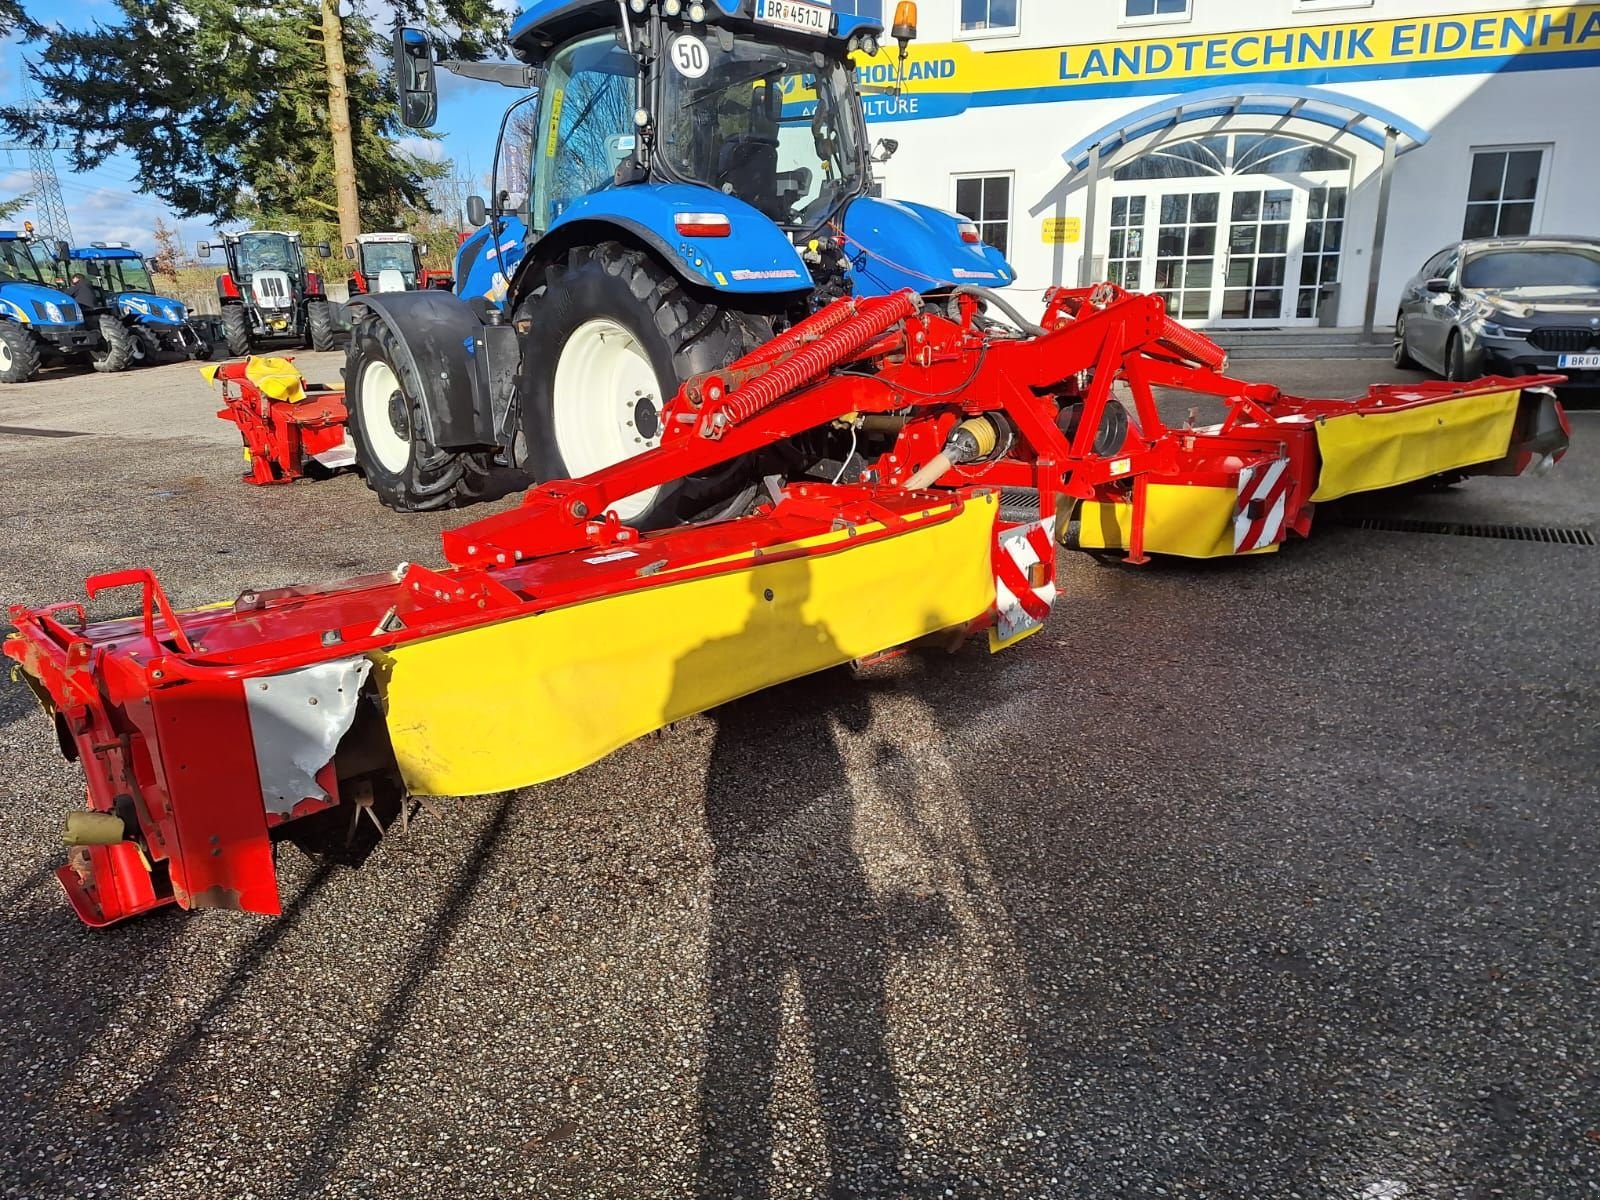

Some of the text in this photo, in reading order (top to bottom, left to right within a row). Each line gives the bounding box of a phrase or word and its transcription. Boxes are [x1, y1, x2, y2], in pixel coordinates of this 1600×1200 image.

[767, 1, 783, 18] BR
[1059, 10, 1600, 80] LANDTECHNIK EIDENHA
[678, 43, 703, 69] 50
[1571, 356, 1585, 366] BR
